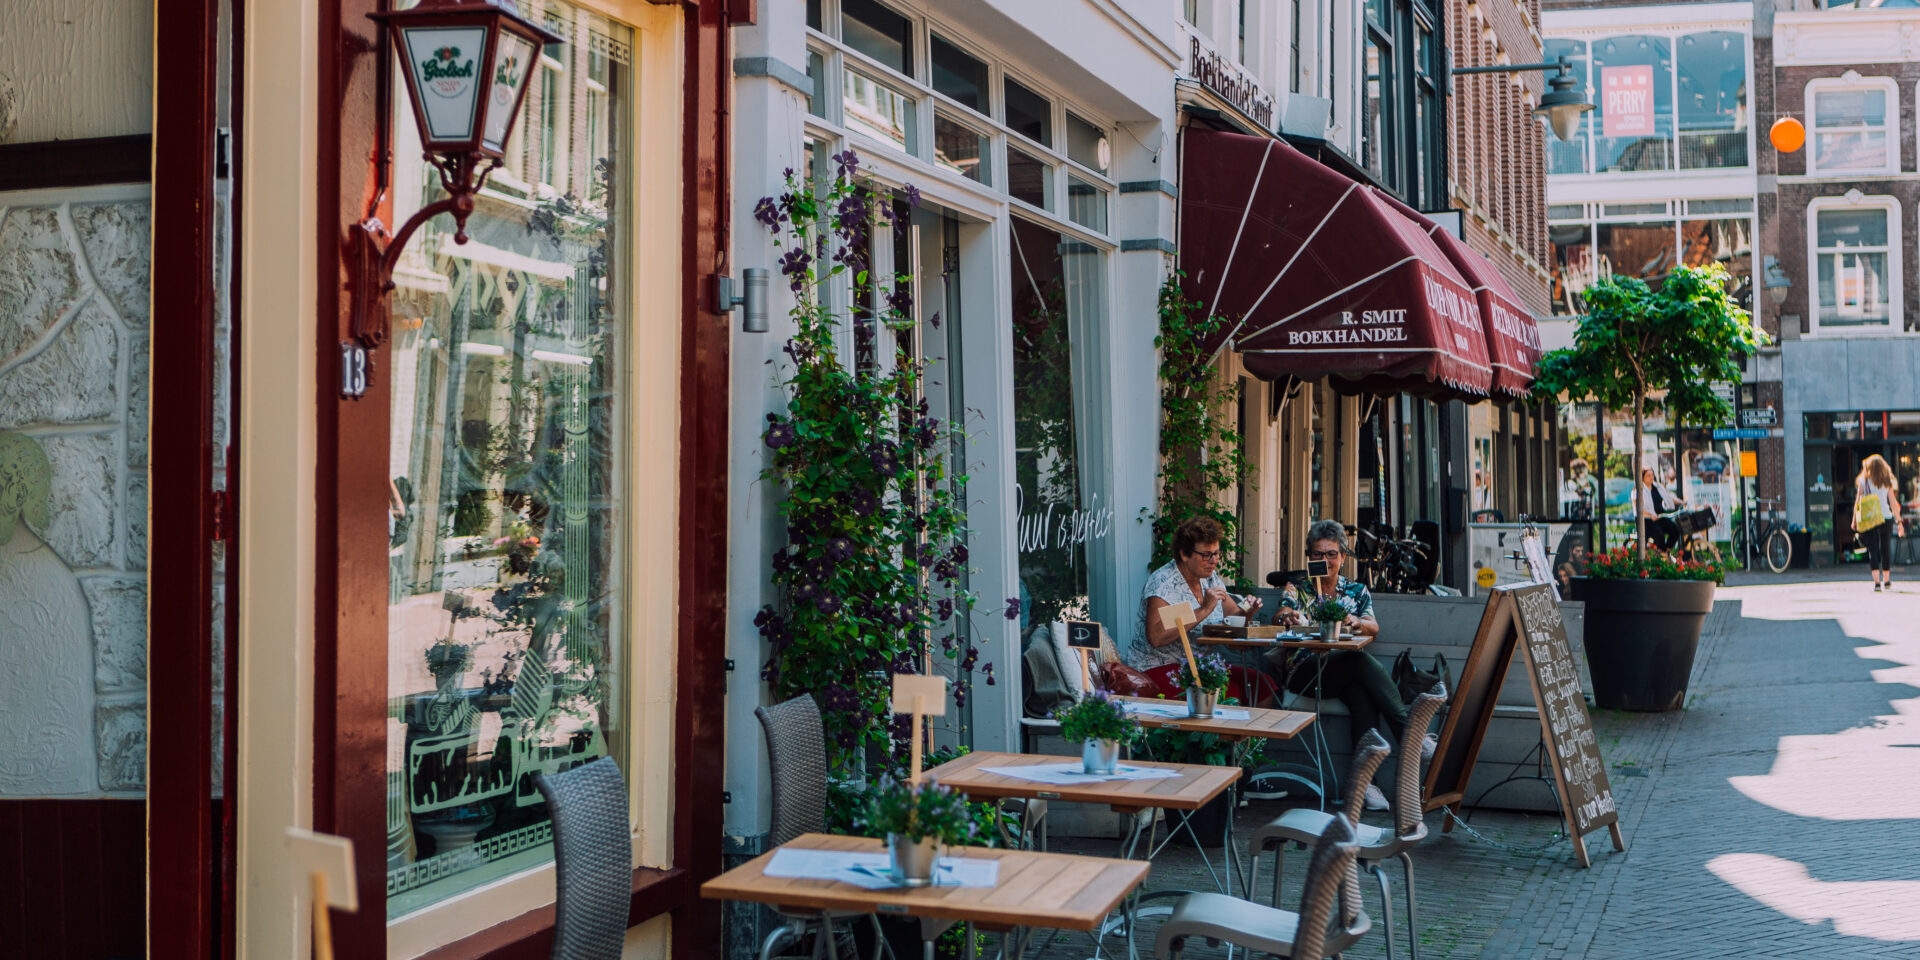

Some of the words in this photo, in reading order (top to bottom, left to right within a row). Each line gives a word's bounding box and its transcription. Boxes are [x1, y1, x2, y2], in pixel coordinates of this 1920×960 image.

[422, 58, 473, 82] Grolsch
[1191, 35, 1250, 115] Boekhandel
[1251, 84, 1273, 129] Smit
[1608, 88, 1647, 115] PERRY
[1341, 311, 1358, 325] R.
[1362, 309, 1407, 324] SMIT
[1288, 327, 1408, 345] BOEKHANDEL
[343, 348, 366, 393] 13
[1057, 513, 1067, 549] is
[1069, 492, 1113, 568] perfect
[1074, 627, 1090, 640] D
